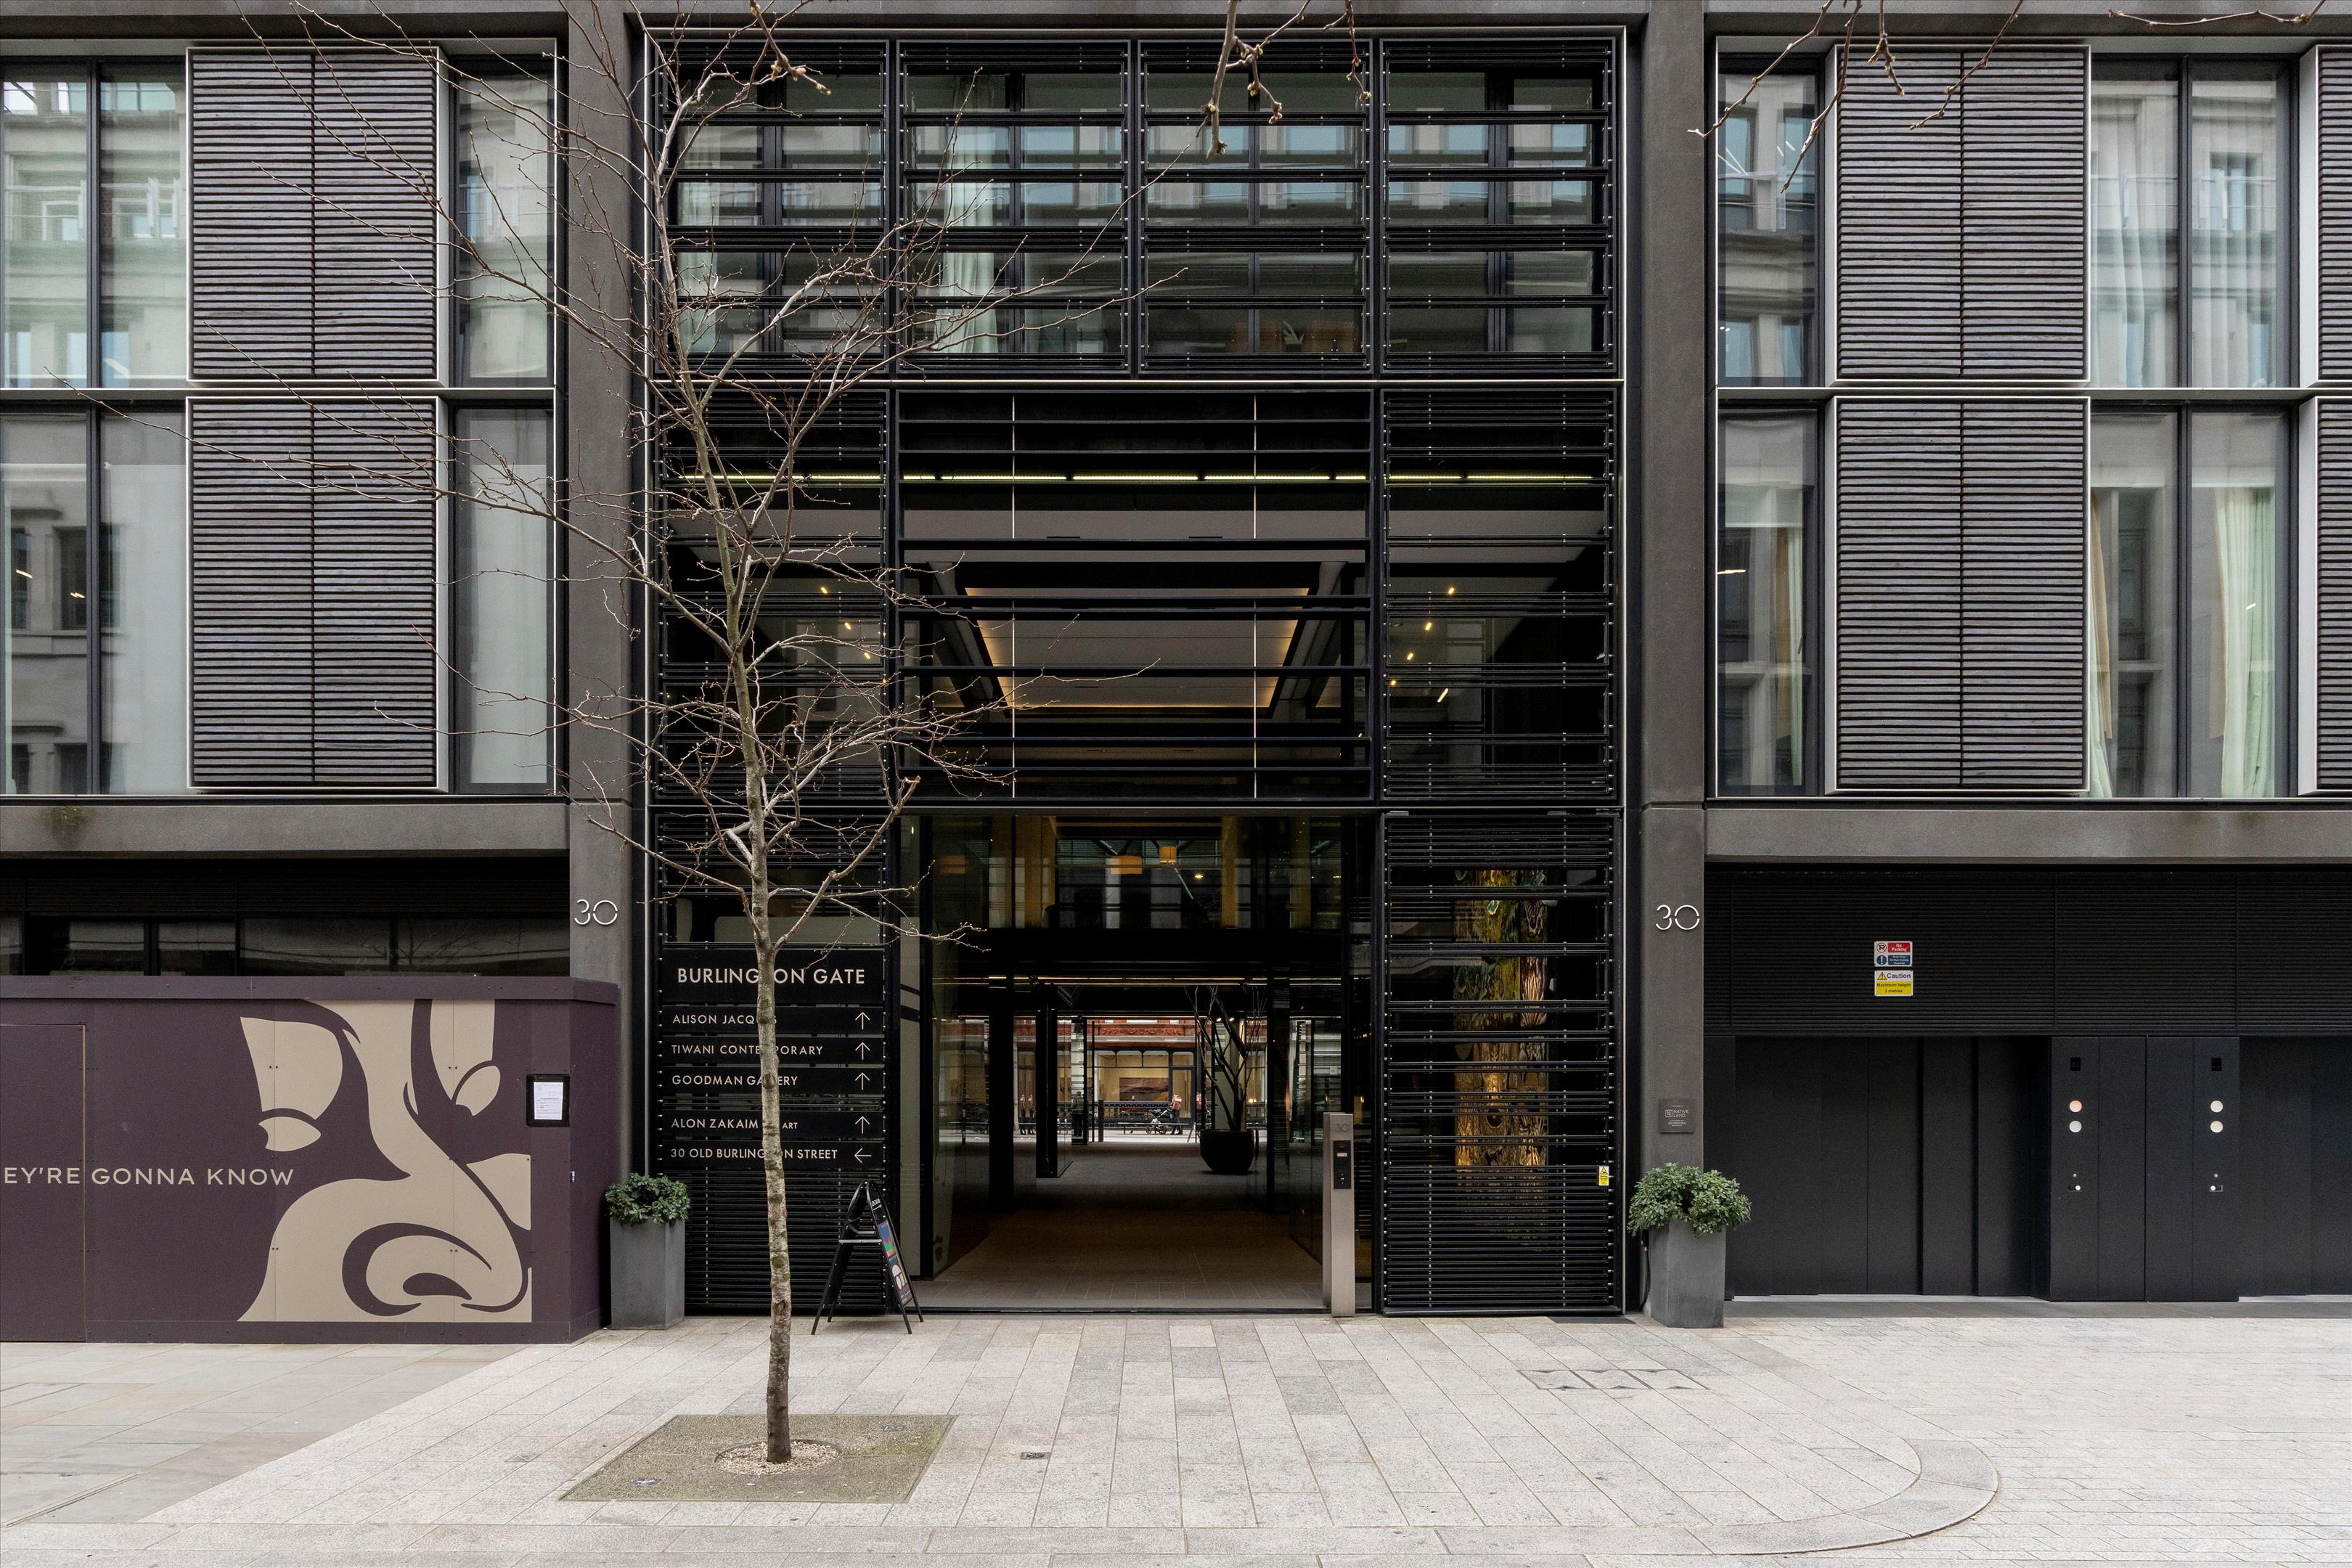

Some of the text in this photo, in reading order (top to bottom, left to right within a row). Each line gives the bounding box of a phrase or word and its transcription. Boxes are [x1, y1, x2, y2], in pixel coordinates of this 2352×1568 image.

[574, 899, 618, 925] 30
[1655, 905, 1700, 931] 30
[677, 968, 865, 984] BURLINGON GATE
[672, 1014, 777, 1025] ALISON JACQ
[671, 1045, 822, 1055] TIWANI CONTEPORARY
[672, 1075, 798, 1086] GOODMAN GAERY
[671, 1119, 706, 1128] ALON
[709, 1119, 759, 1129] ZAKAIM
[670, 1148, 838, 1159] 30 OLD BURLINGN STREET
[4, 1167, 294, 1186] EY'RE GONNA KNOW
